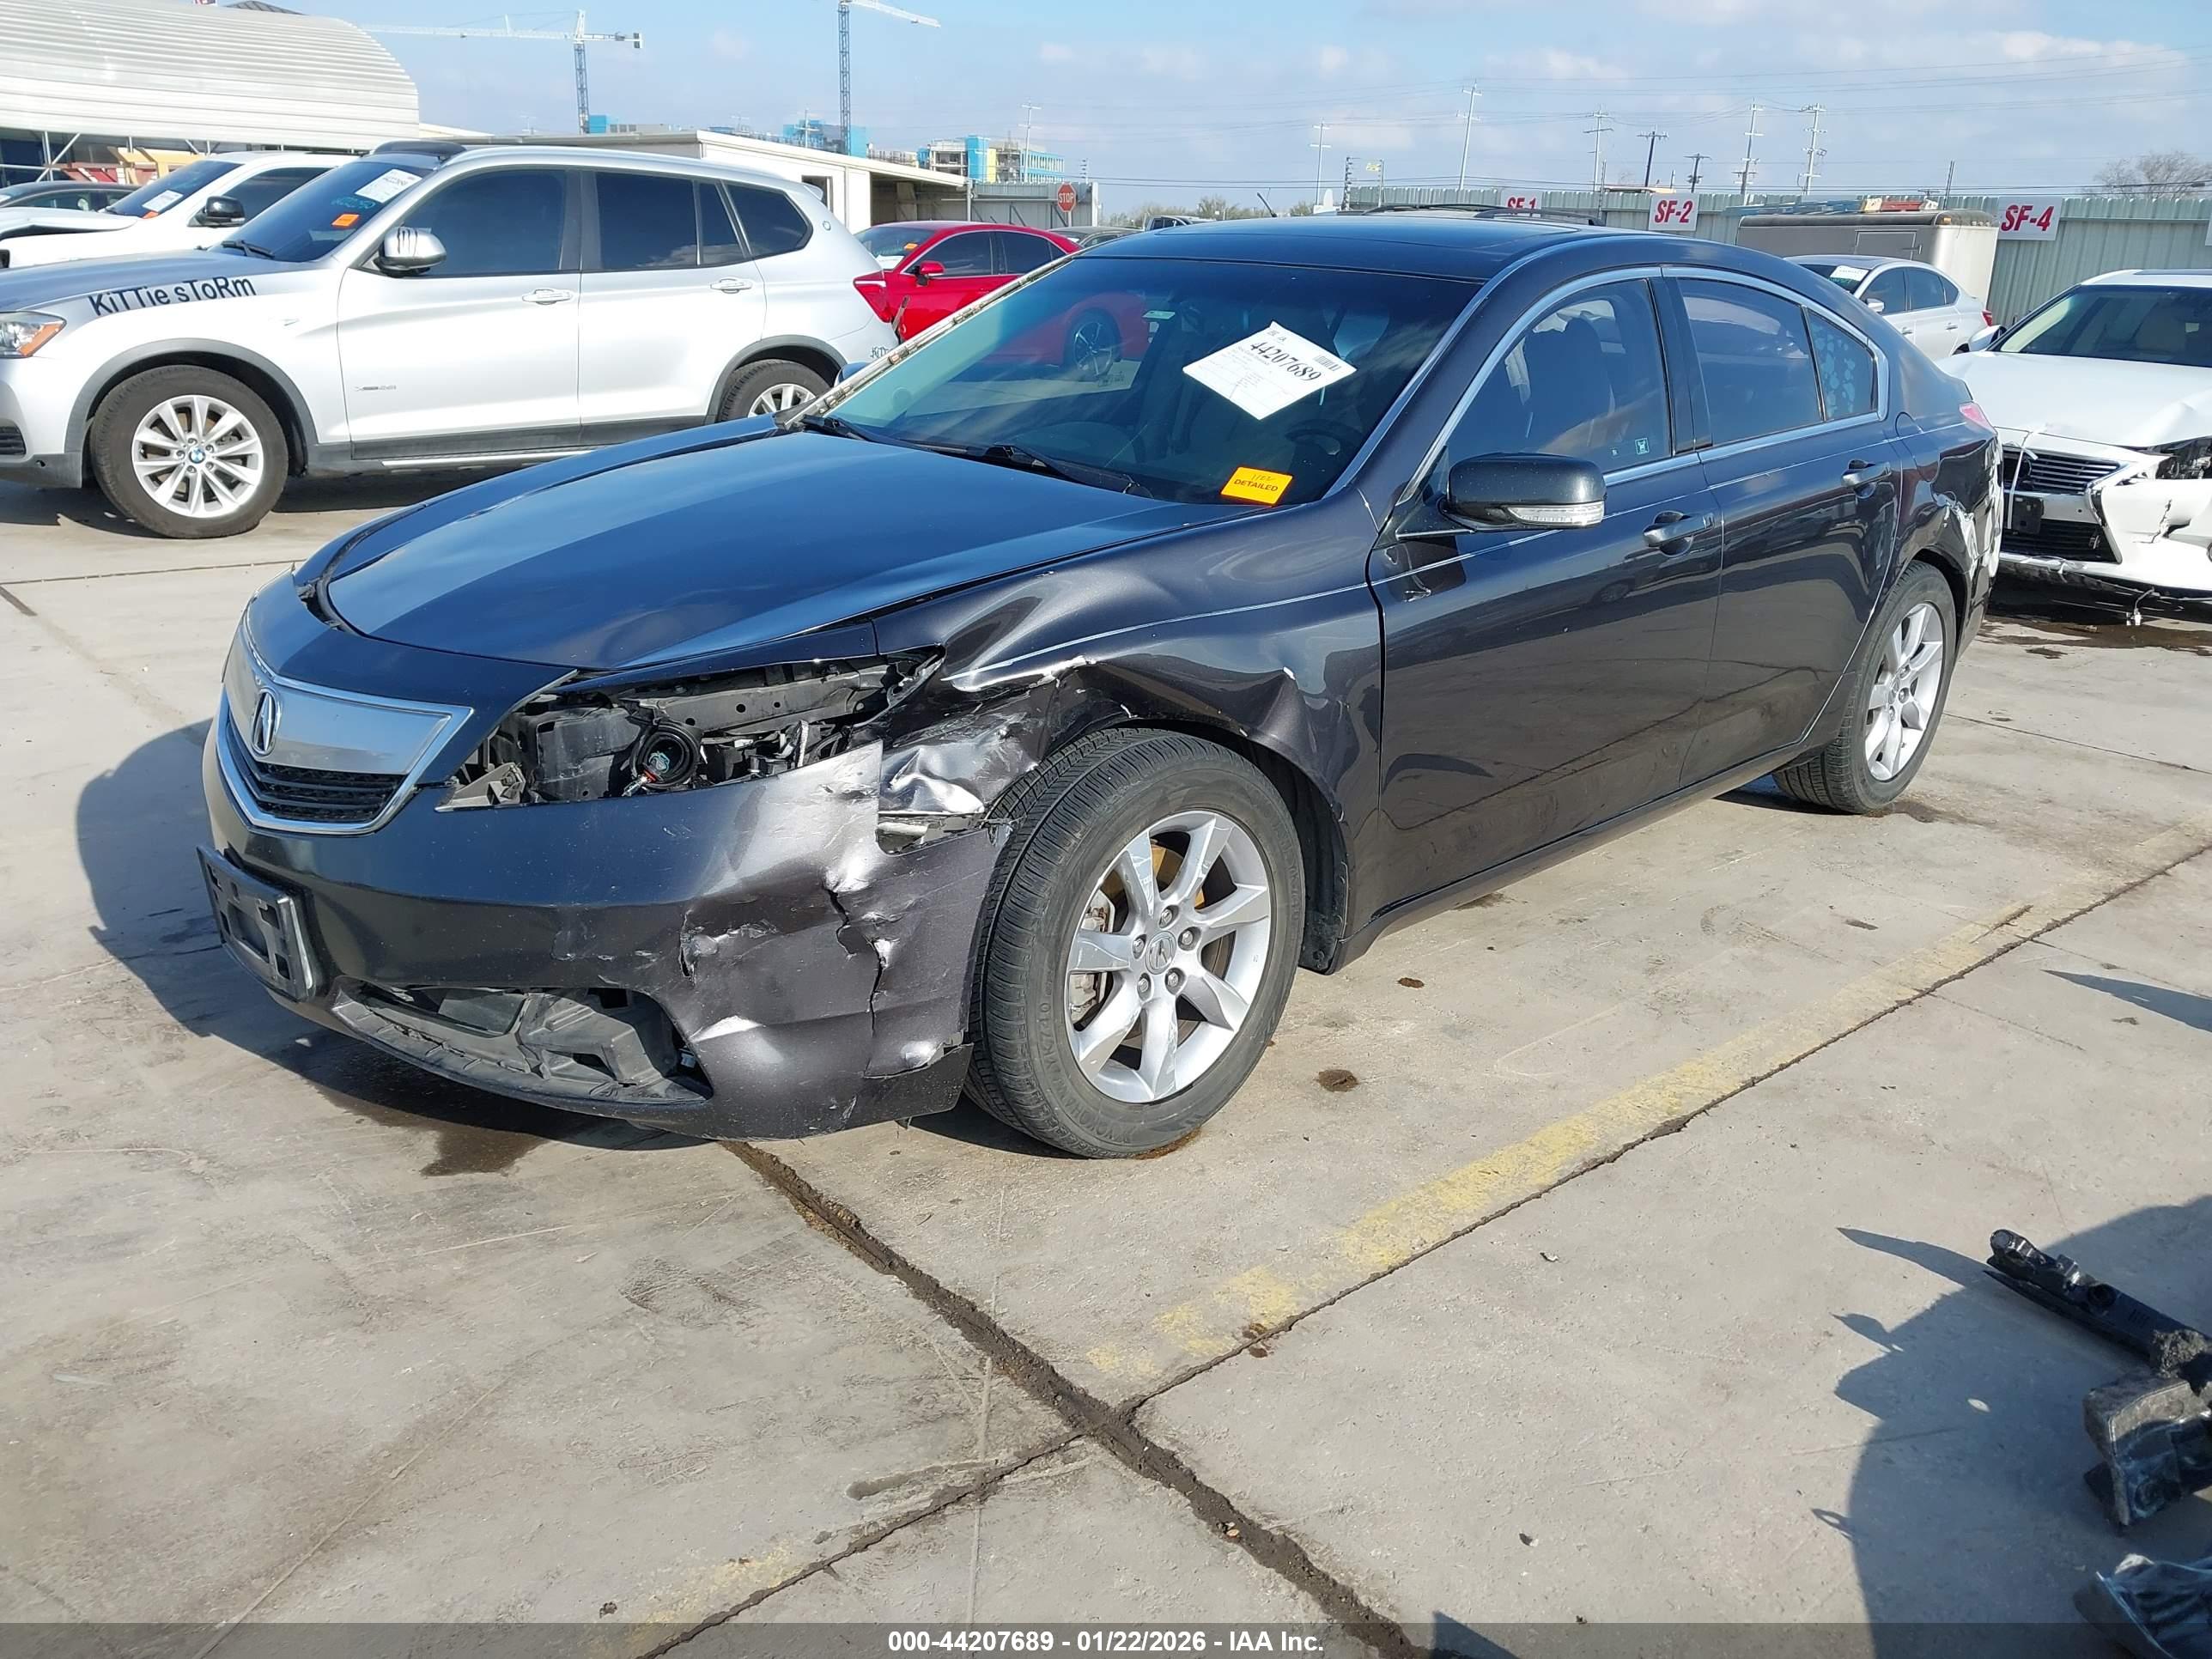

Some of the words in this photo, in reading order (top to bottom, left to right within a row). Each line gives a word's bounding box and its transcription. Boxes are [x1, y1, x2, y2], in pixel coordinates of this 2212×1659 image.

[1058, 192, 1074, 204] STOP
[1654, 199, 1693, 223] SF-2
[2000, 204, 2055, 232] SF-4
[1249, 341, 1322, 382] 44207689
[1233, 478, 1279, 492] DETAILED
